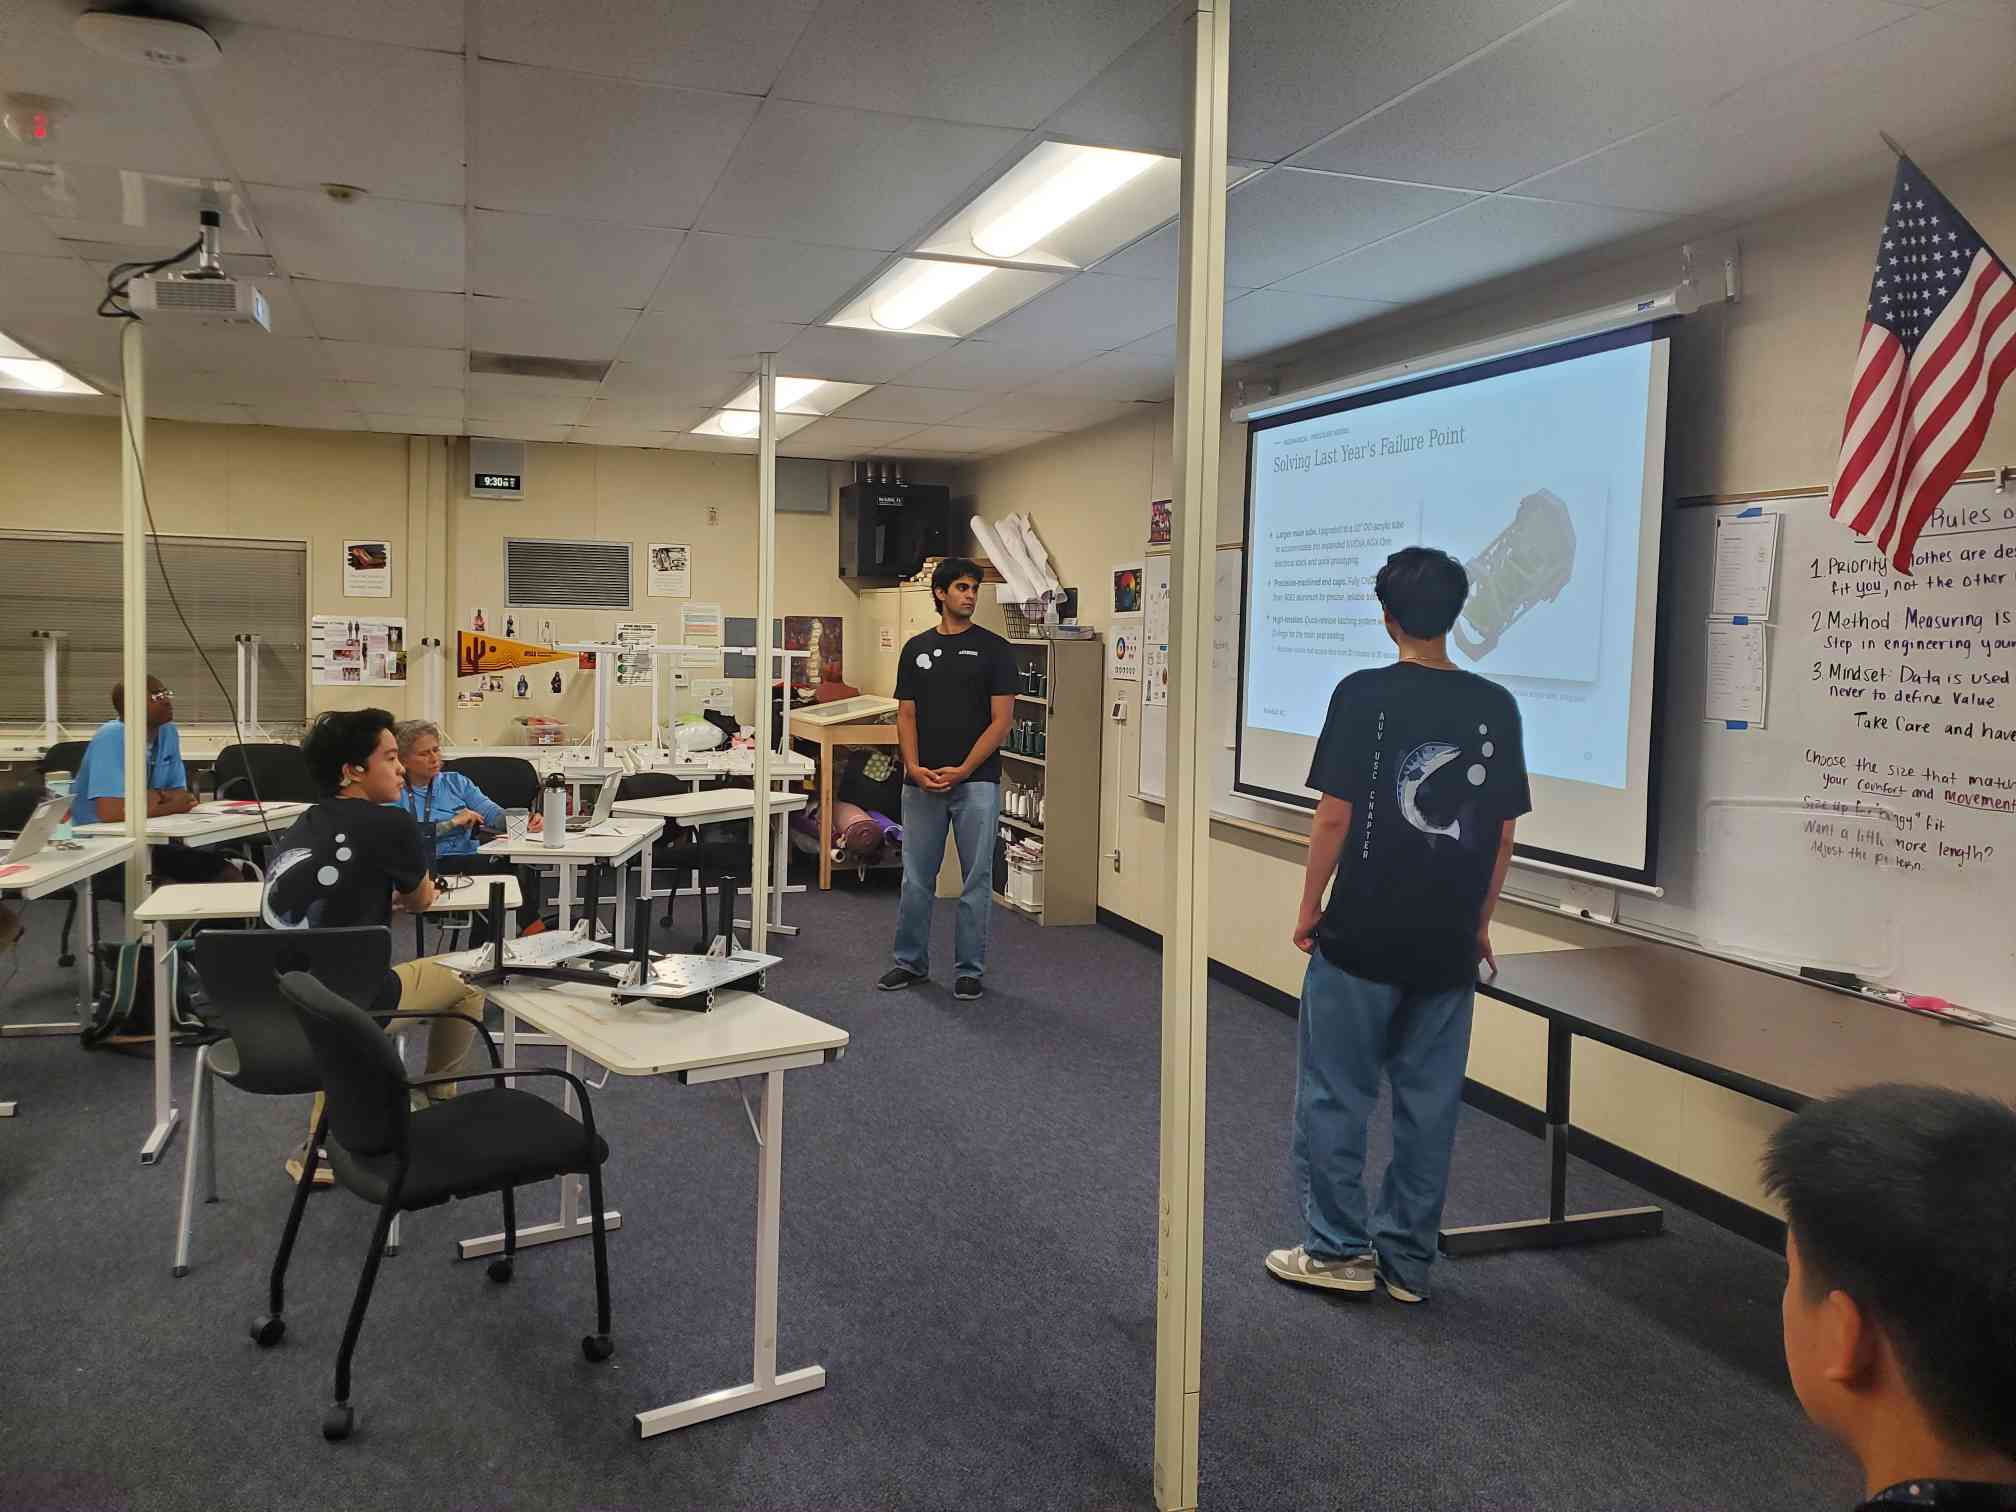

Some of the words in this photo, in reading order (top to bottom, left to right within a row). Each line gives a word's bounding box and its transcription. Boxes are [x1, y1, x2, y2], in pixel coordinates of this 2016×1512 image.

[1273, 455, 1311, 473] Solving
[1314, 448, 1338, 467] Last
[1341, 440, 1376, 463] Year's
[1380, 434, 1424, 456] Failure
[1429, 425, 1465, 448] Point
[1932, 506, 1992, 529] Rules
[1911, 550, 1953, 567] lothes
[1960, 548, 1987, 561] are
[1831, 580, 1851, 596] fit
[1894, 580, 1918, 592] not
[1927, 575, 1953, 590] the
[1962, 572, 2006, 588] other
[1827, 610, 1890, 630] Method
[1905, 606, 1983, 634] Measuring
[1862, 639, 1876, 650] in
[1884, 638, 1971, 659] engineering
[1900, 664, 1941, 686] Data
[1947, 673, 1962, 685] is
[1971, 671, 2010, 685] used
[1829, 684, 1866, 698] never
[1871, 688, 1887, 701] to
[1894, 688, 1942, 705] define
[1853, 711, 1889, 730] Take
[1944, 722, 1974, 739] and
[1982, 721, 2016, 742] have
[1806, 748, 1848, 769] Choose
[1856, 757, 1878, 774] the
[1921, 767, 1960, 785] that
[1911, 788, 1934, 801] and
[1926, 815, 1945, 832] fit
